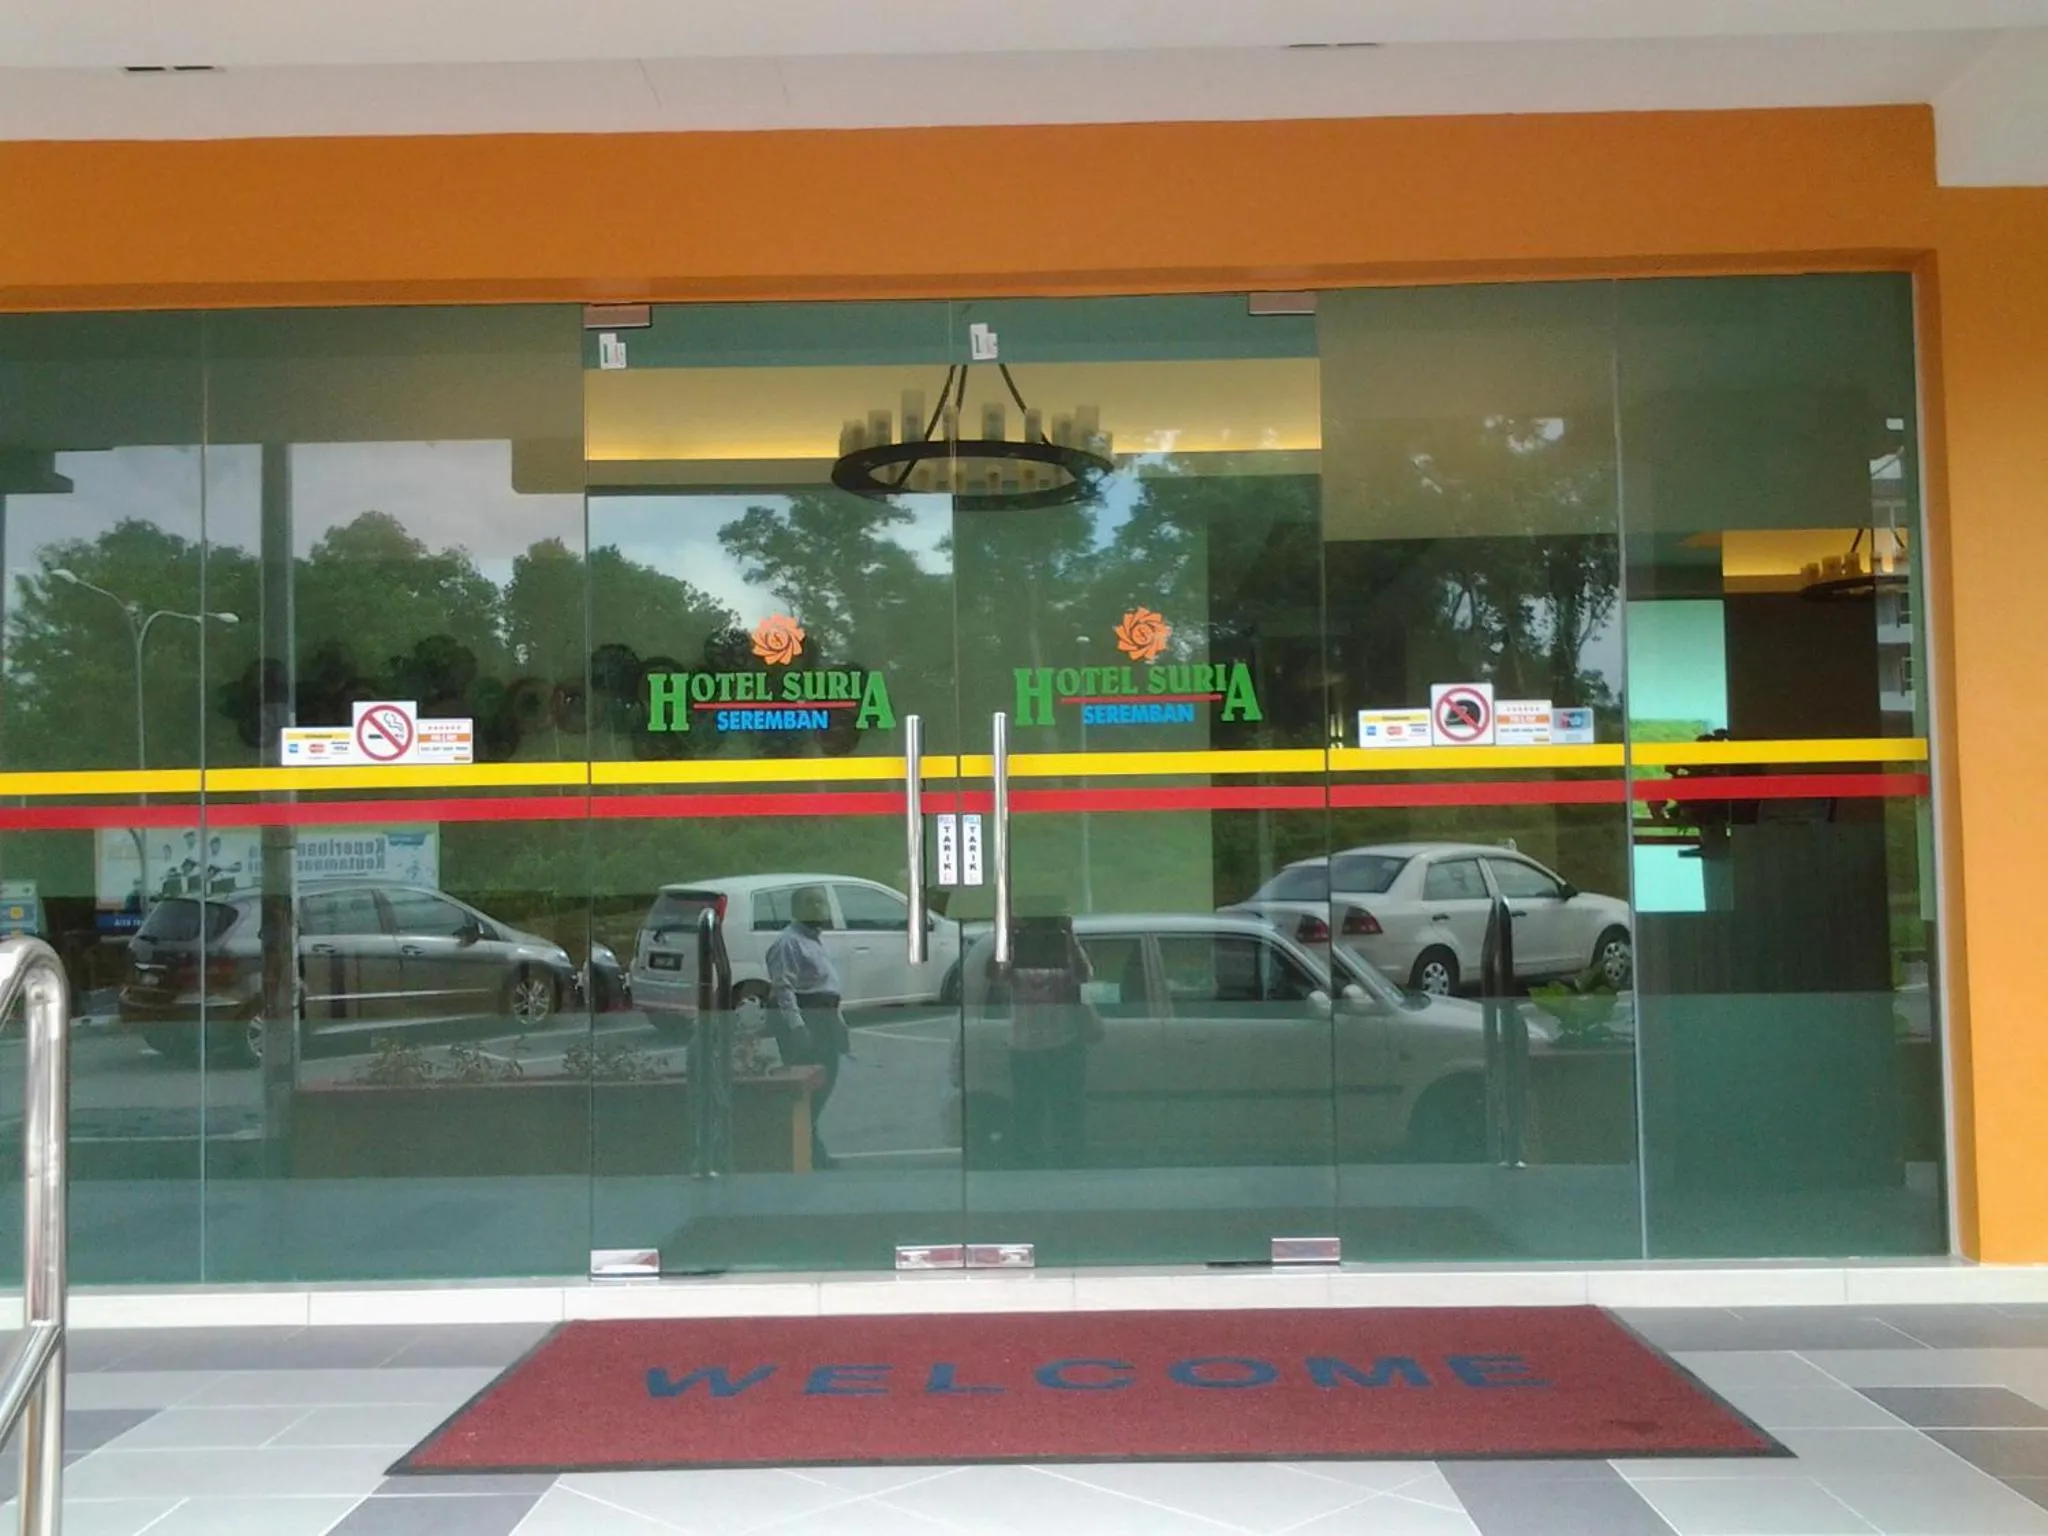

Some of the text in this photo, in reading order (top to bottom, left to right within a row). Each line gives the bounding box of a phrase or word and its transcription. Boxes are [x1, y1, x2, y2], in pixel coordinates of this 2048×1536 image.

[647, 671, 896, 731] HOTEL SURIA
[1014, 663, 1263, 726] HOTEL SURIA
[1083, 704, 1195, 725] SEREMBAN
[717, 710, 829, 731] SEREMBAN
[943, 826, 952, 871] TARIK
[968, 826, 977, 871] TARIK
[646, 1354, 1554, 1398] WELCOME
